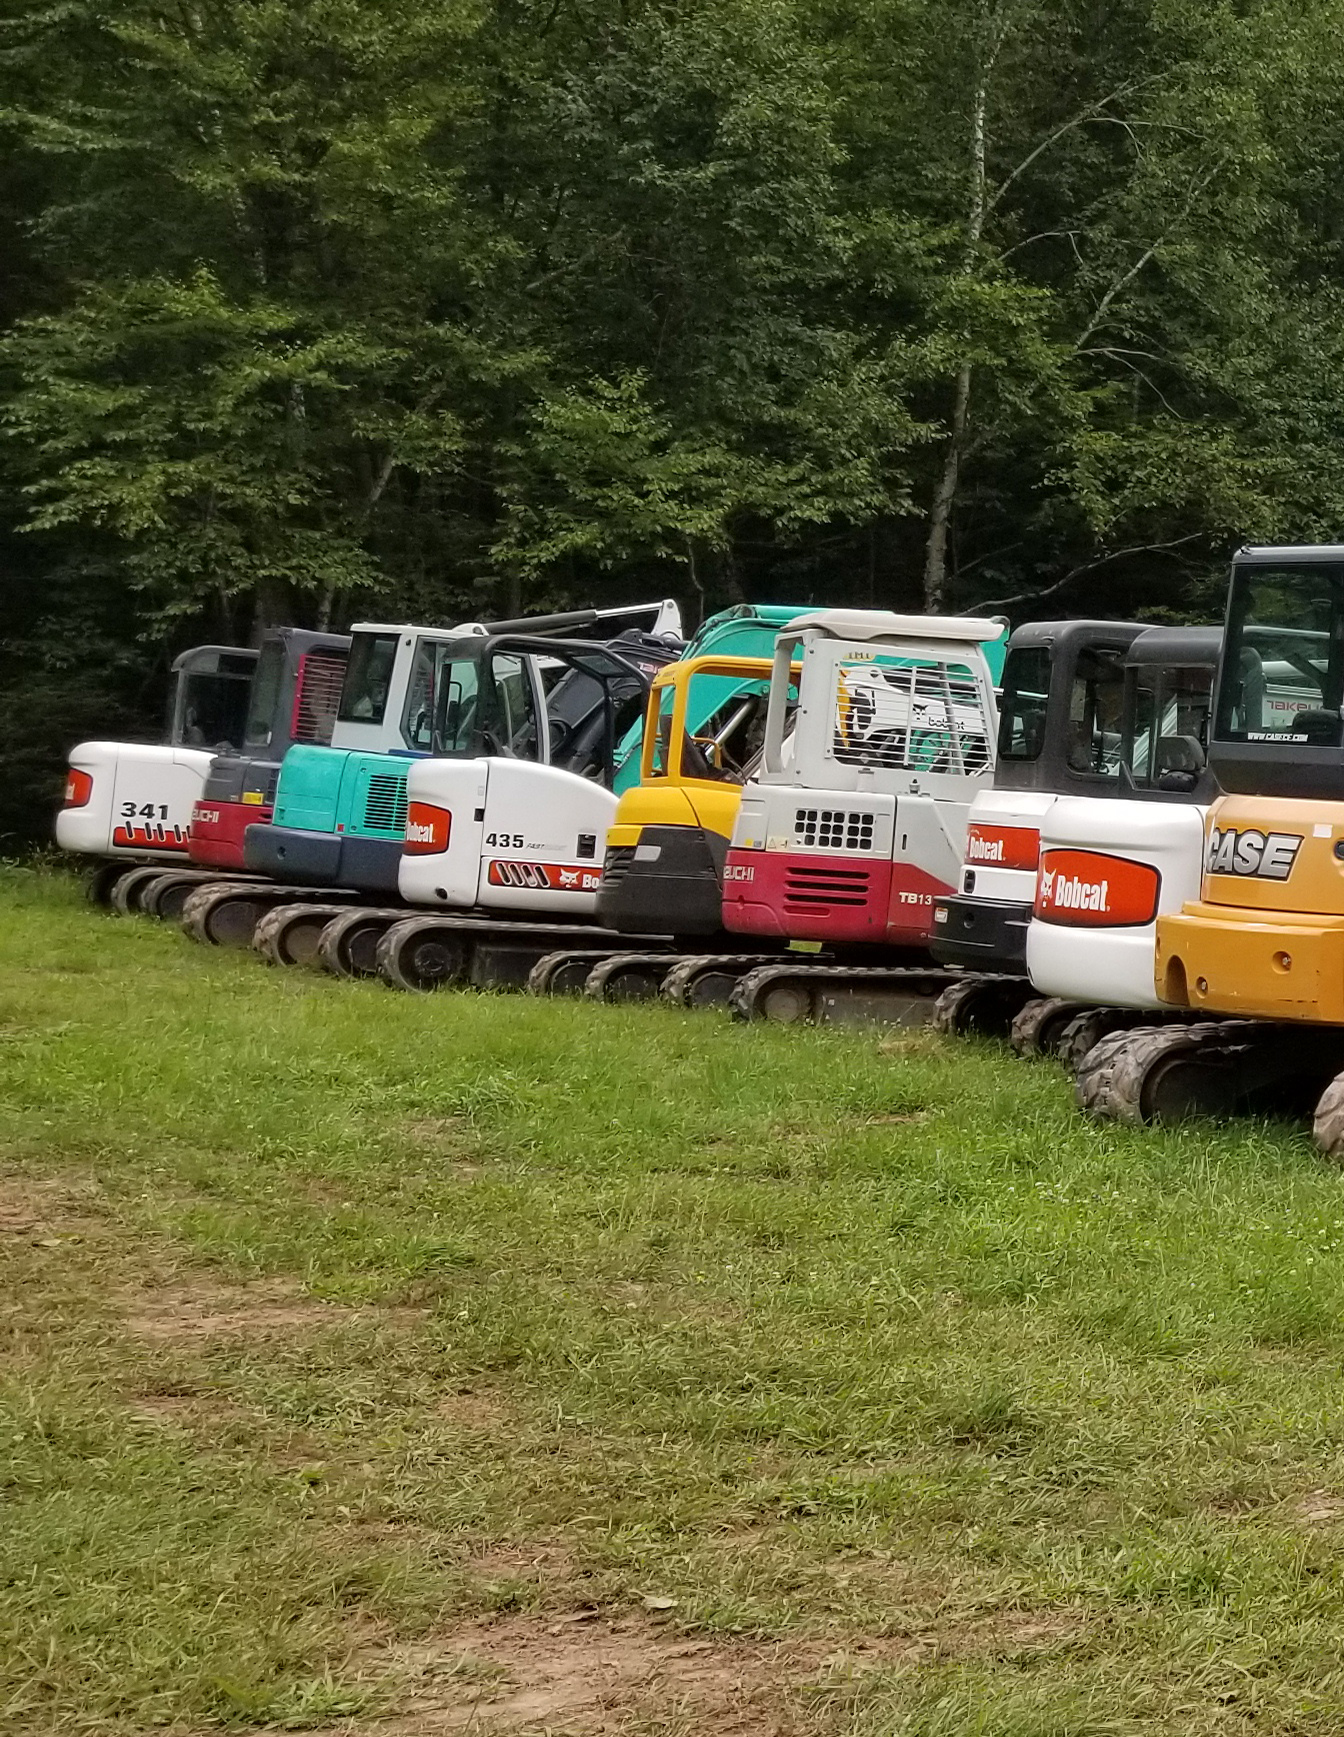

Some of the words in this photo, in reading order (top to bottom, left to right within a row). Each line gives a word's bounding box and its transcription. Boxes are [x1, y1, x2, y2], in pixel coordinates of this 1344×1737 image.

[120, 802, 168, 820] 341
[486, 833, 524, 848] 435
[969, 837, 1003, 861] Bobcat
[1055, 875, 1108, 911] Bobcat
